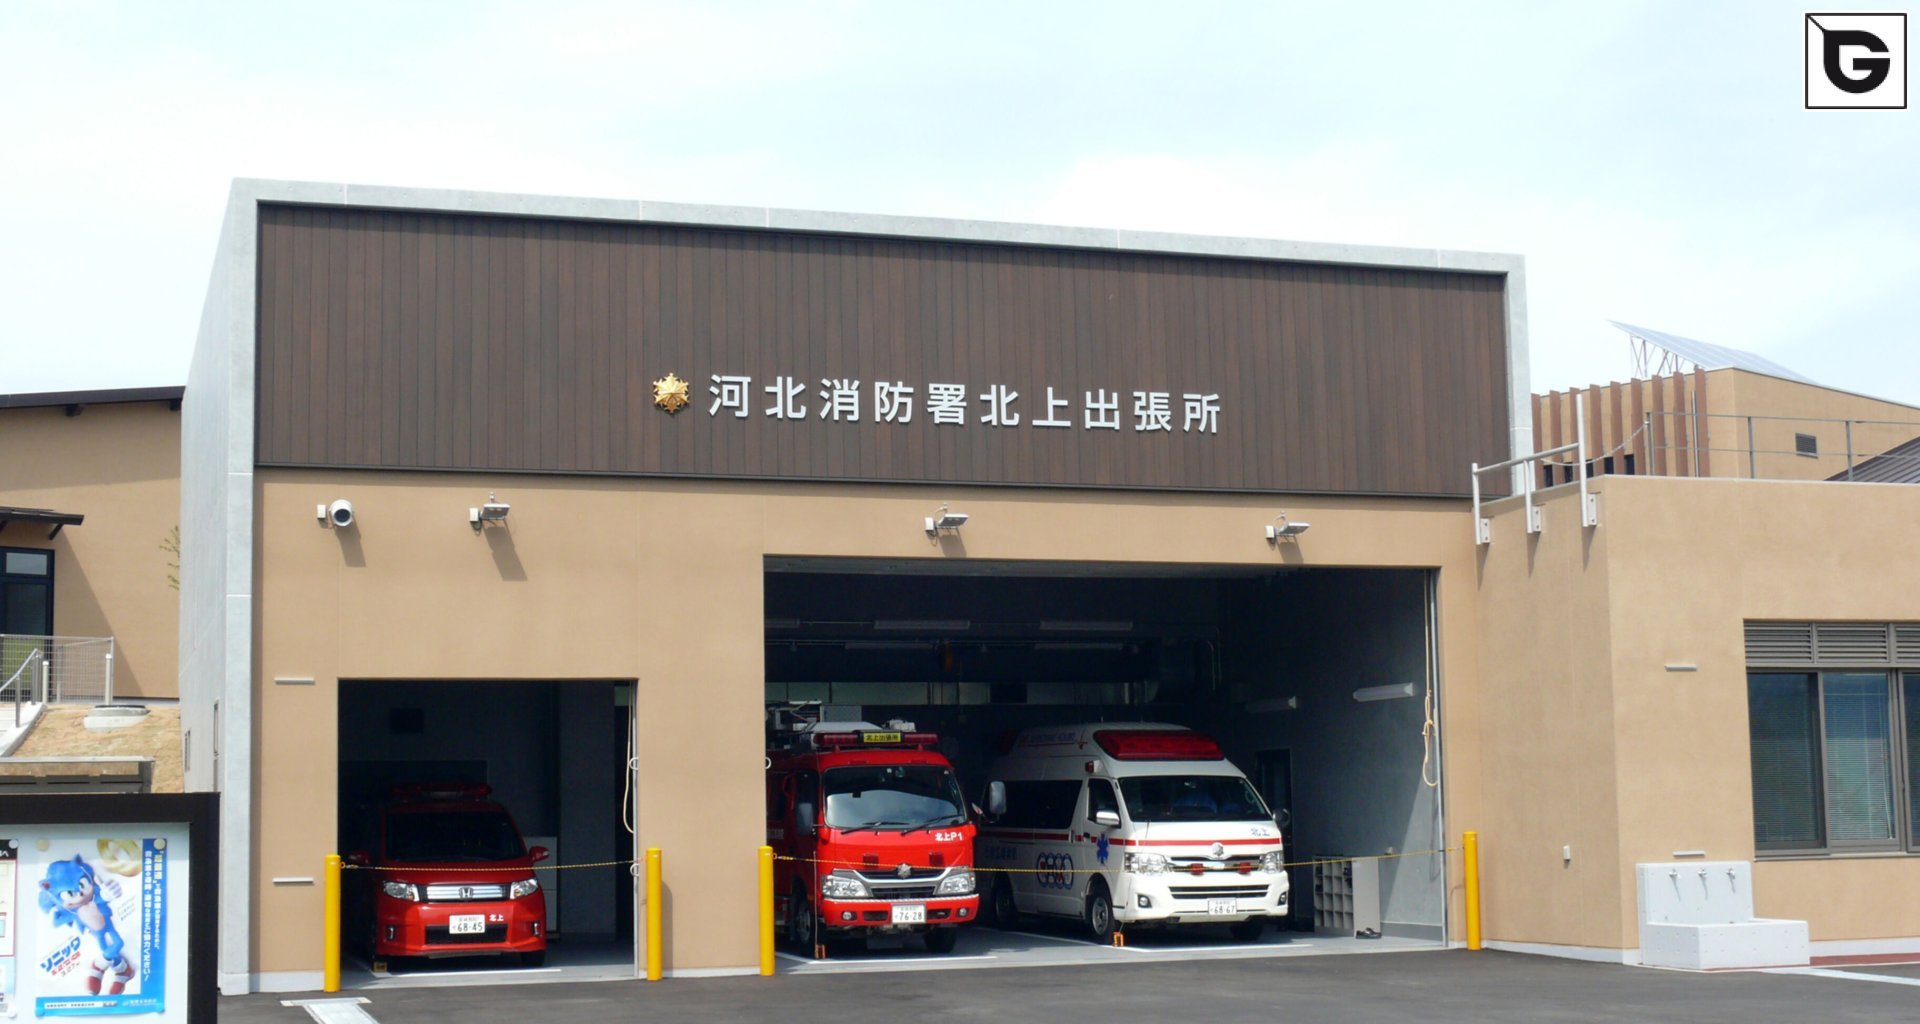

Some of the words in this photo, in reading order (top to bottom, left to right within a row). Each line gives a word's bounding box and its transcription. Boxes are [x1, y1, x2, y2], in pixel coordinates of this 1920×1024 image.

[708, 373, 1221, 434] 河北消防署北上出張所
[489, 914, 504, 922] 北上
[40, 936, 81, 972] ソニック
